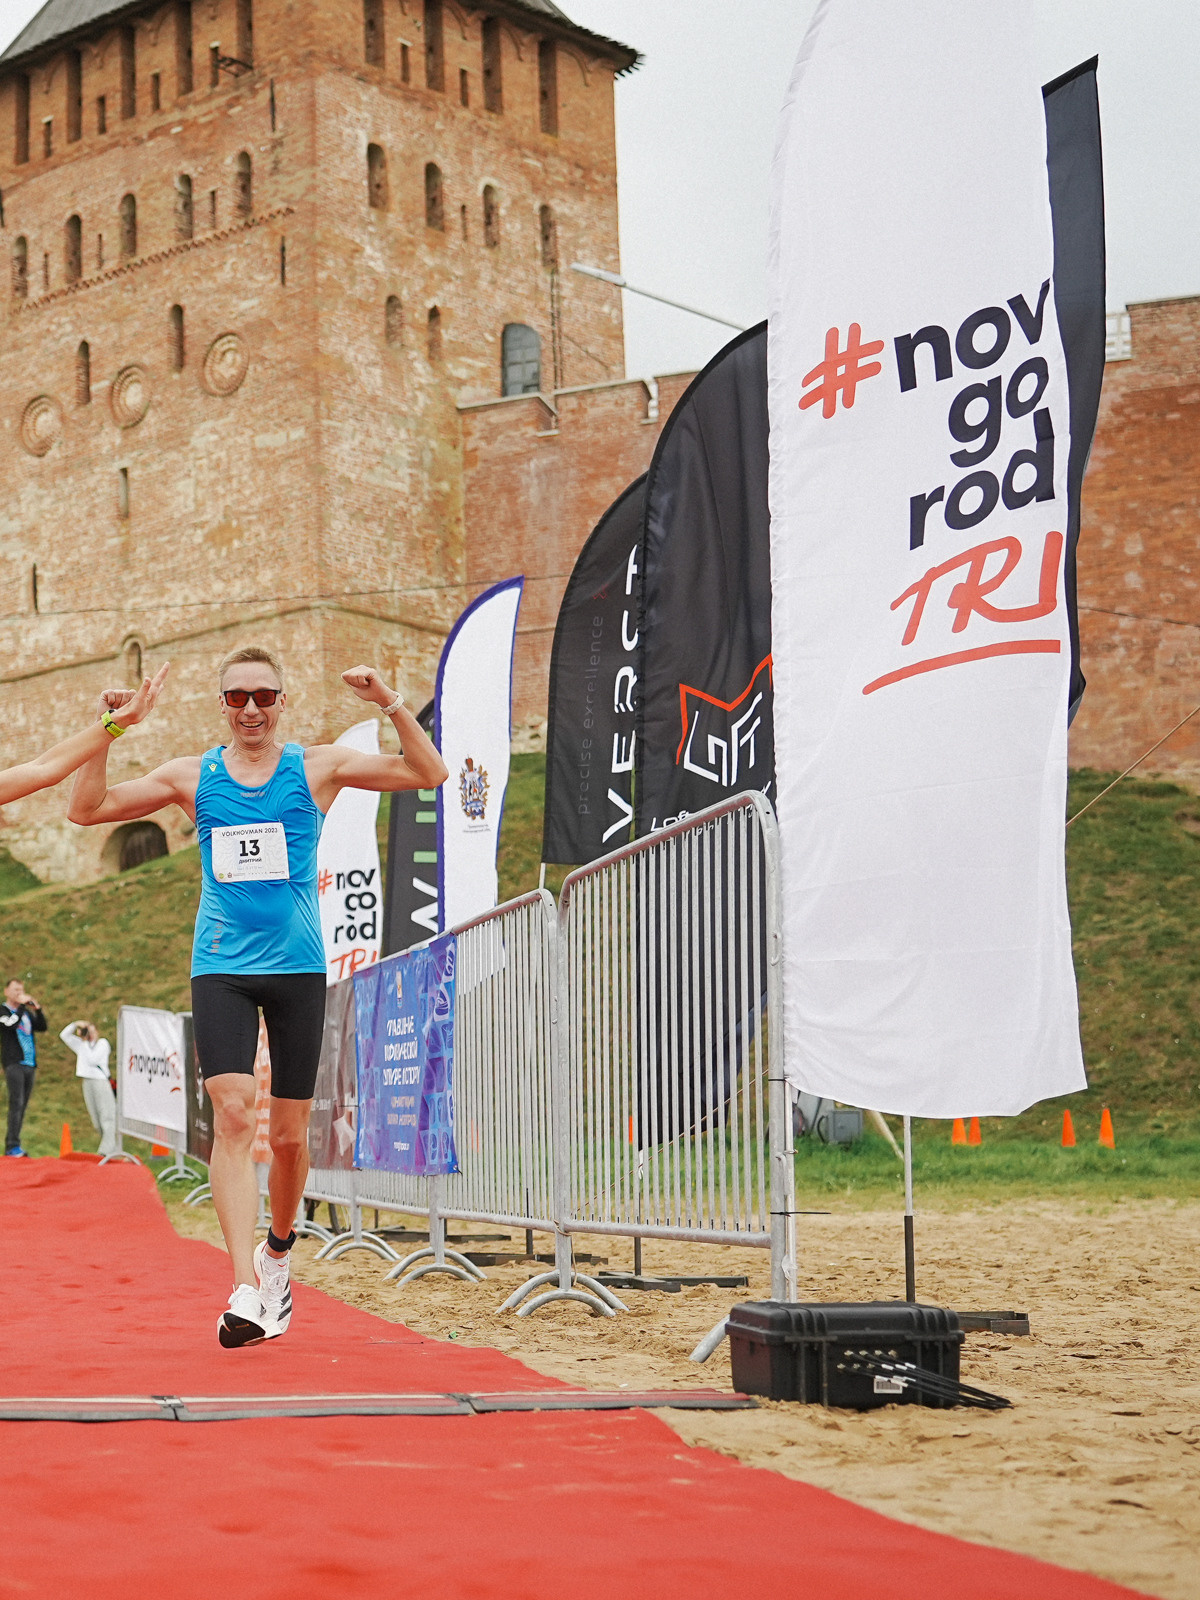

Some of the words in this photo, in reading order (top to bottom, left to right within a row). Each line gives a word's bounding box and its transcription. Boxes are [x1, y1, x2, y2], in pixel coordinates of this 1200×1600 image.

[798, 277, 1051, 419] #nov
[948, 356, 1050, 468] go
[909, 407, 1056, 550] rod
[890, 531, 1064, 646] TRI
[239, 839, 260, 857] 13
